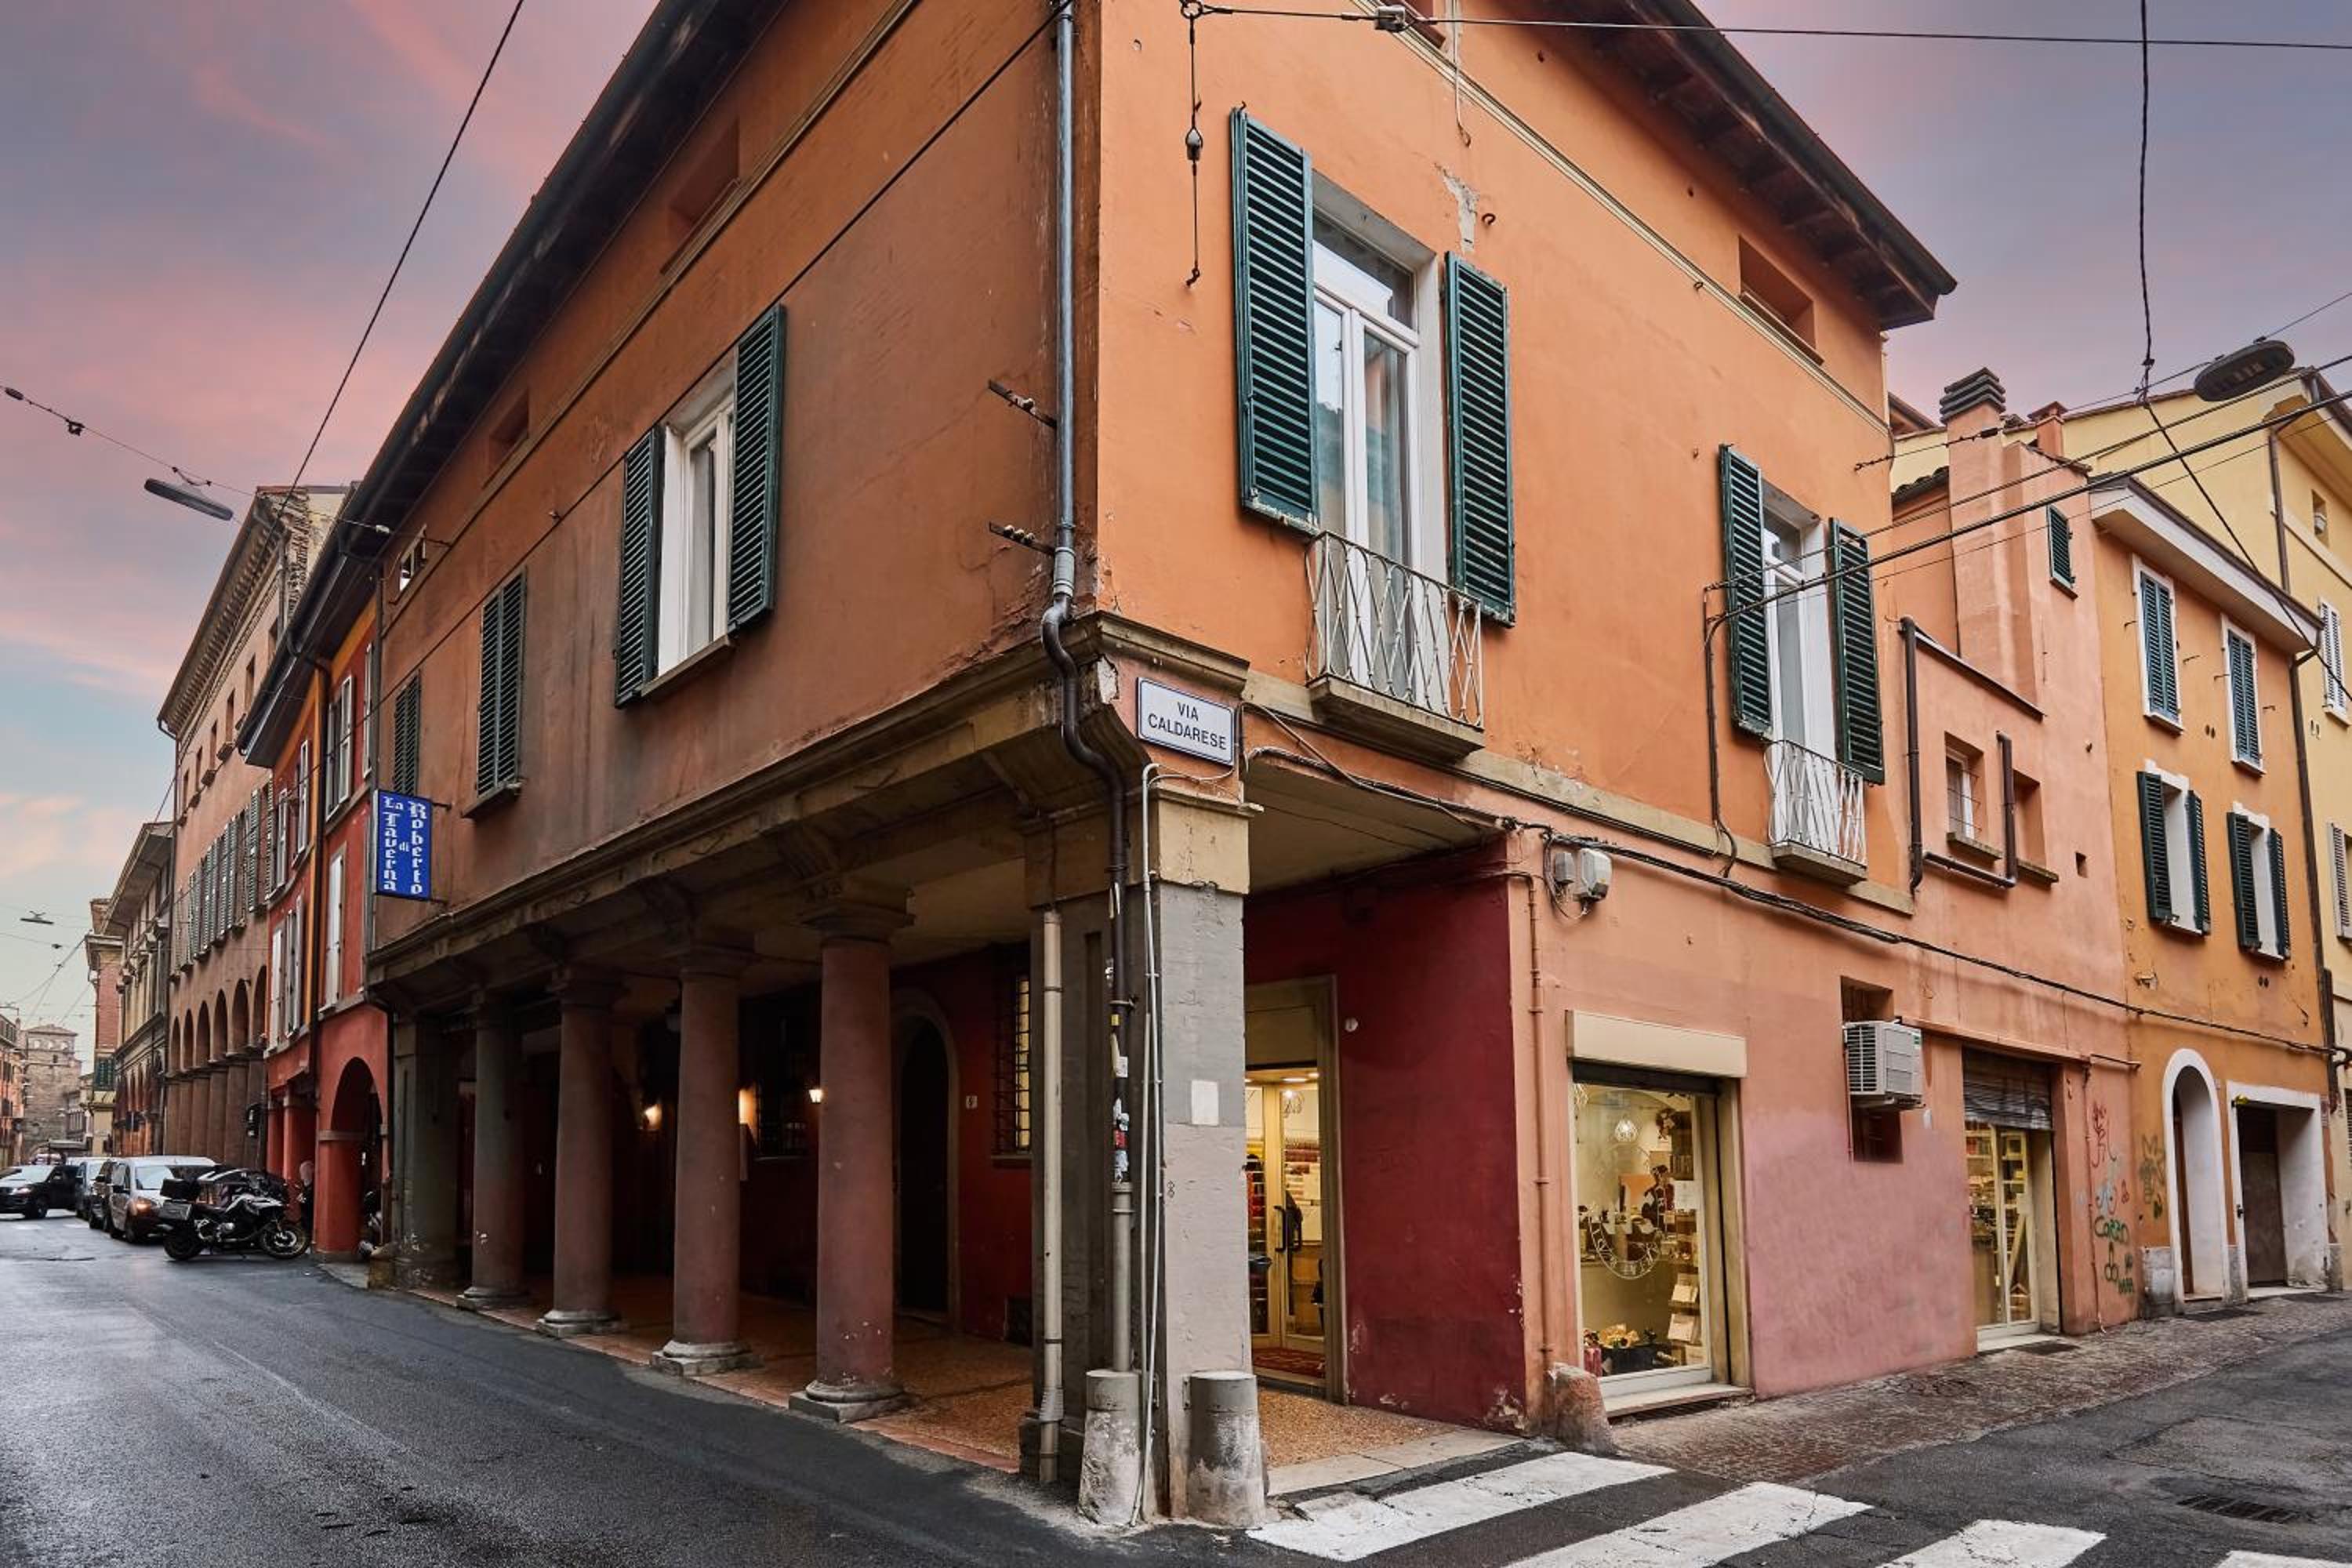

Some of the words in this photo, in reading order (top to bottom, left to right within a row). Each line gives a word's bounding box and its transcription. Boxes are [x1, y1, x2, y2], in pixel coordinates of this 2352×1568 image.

[1177, 702, 1199, 721] VIA
[1148, 713, 1227, 750] CALDARESE
[383, 796, 404, 811] La
[398, 841, 410, 852] di
[408, 800, 427, 895] Roberto
